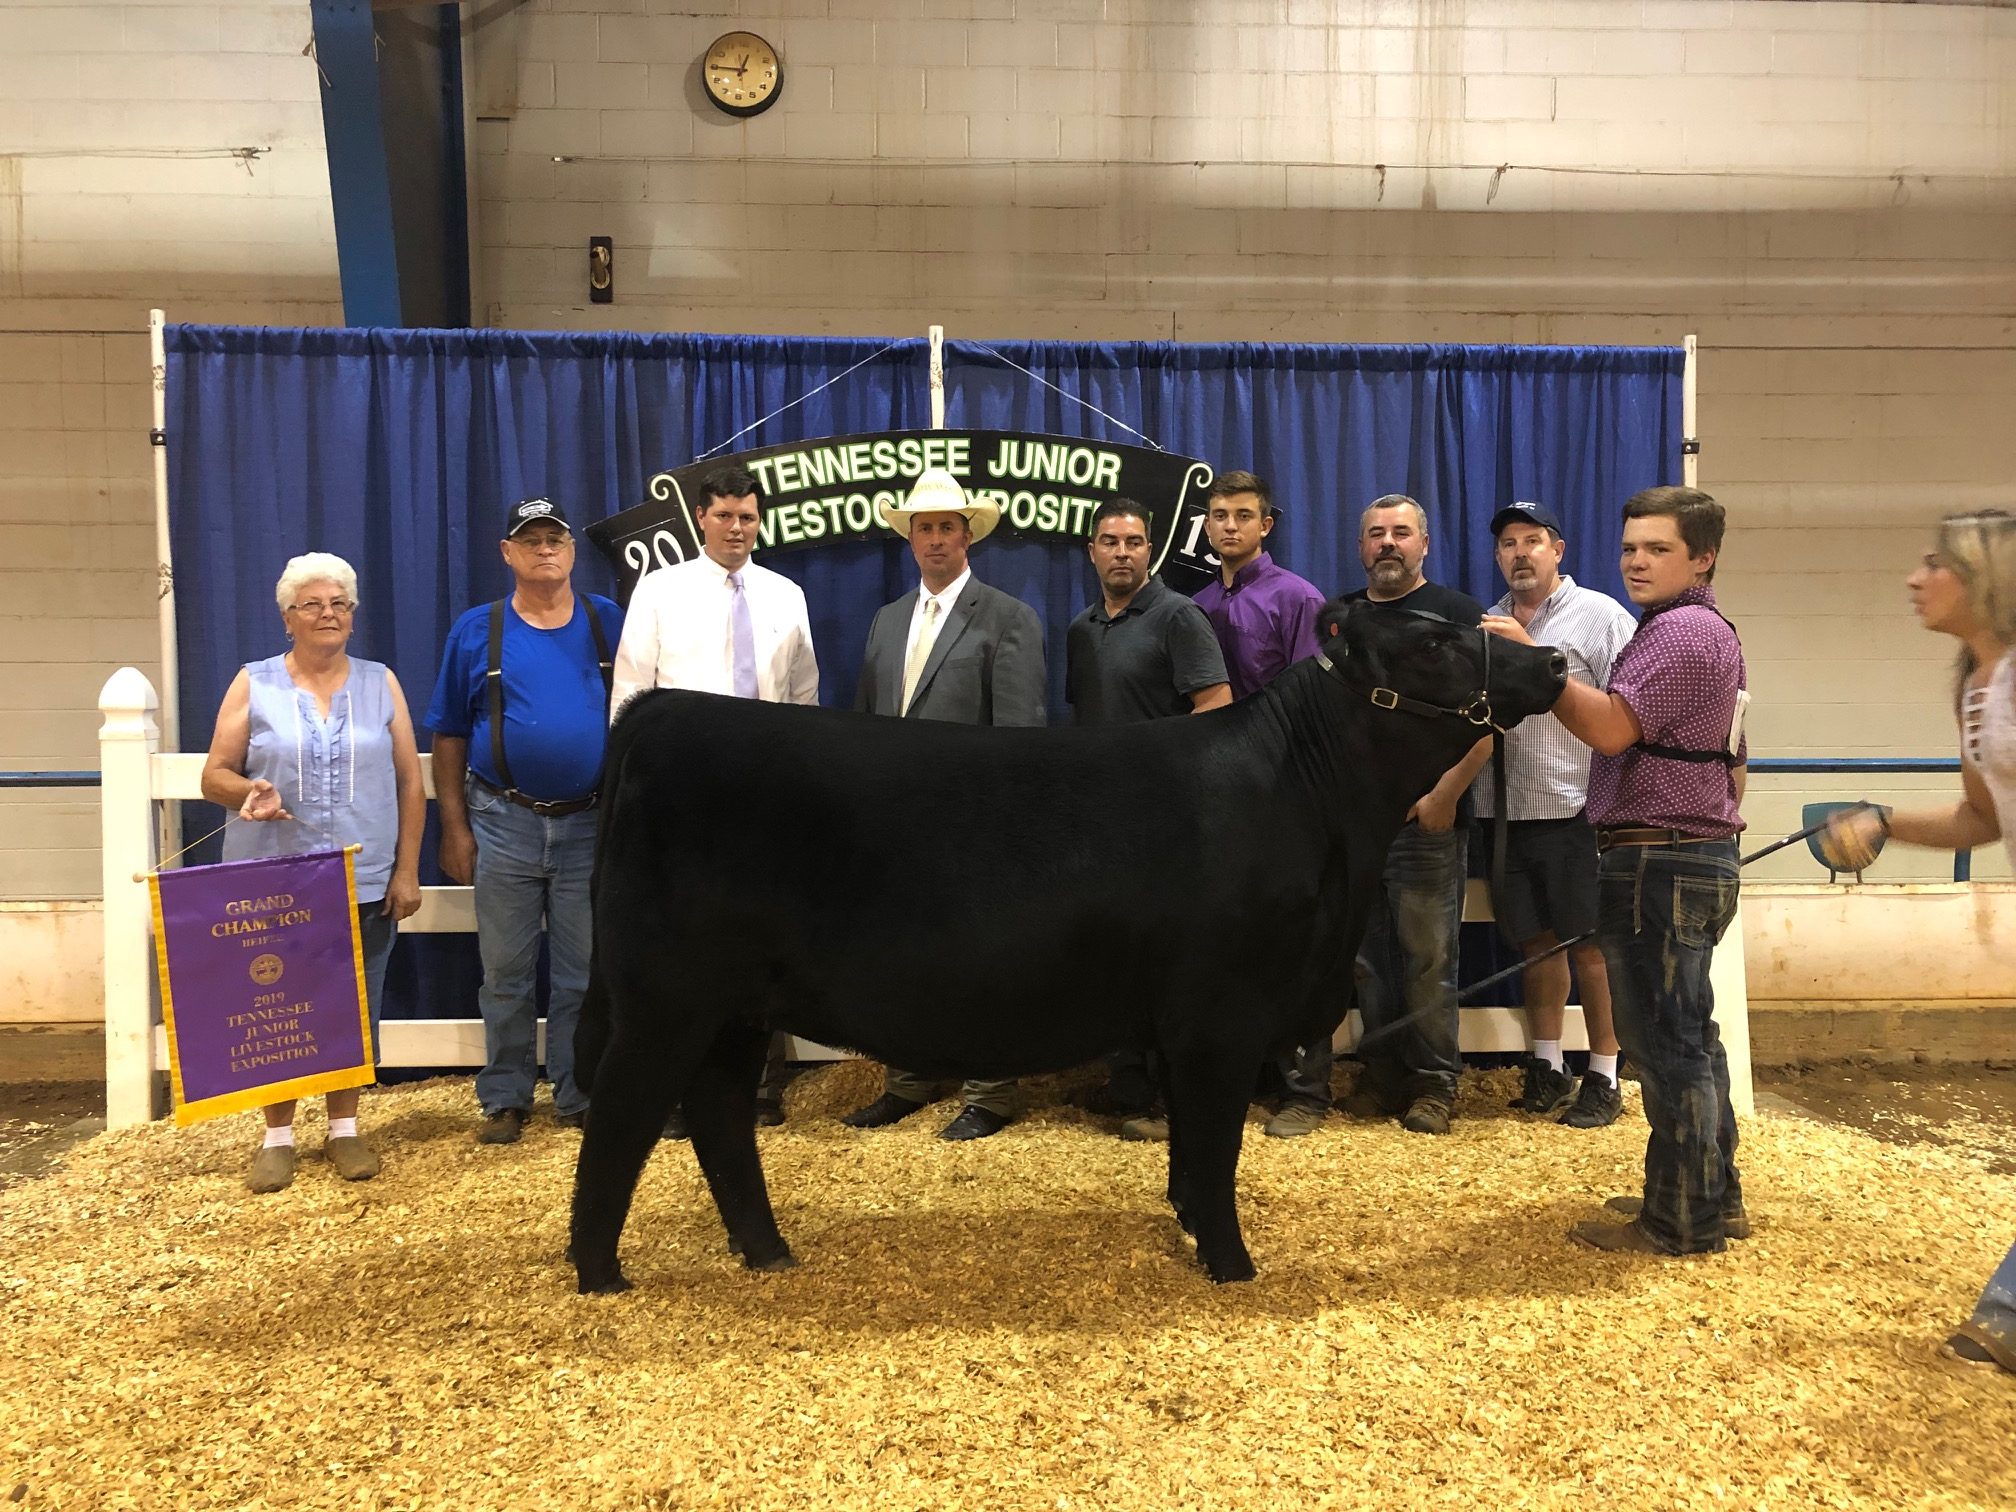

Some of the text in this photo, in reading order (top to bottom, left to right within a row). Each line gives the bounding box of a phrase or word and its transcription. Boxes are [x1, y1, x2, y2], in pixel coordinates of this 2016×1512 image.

[748, 438, 1122, 496] TENNESSEE JUNIOR
[752, 489, 912, 550] VESTOC
[225, 894, 295, 916] GRAND
[211, 909, 311, 938] CHAMION
[253, 991, 285, 1008] 2019
[226, 1001, 314, 1028] TENNESSEE
[245, 1018, 299, 1040] JUNIOR
[230, 1031, 315, 1057] LIVESTOCK
[231, 1045, 319, 1073] EXPOSITION
